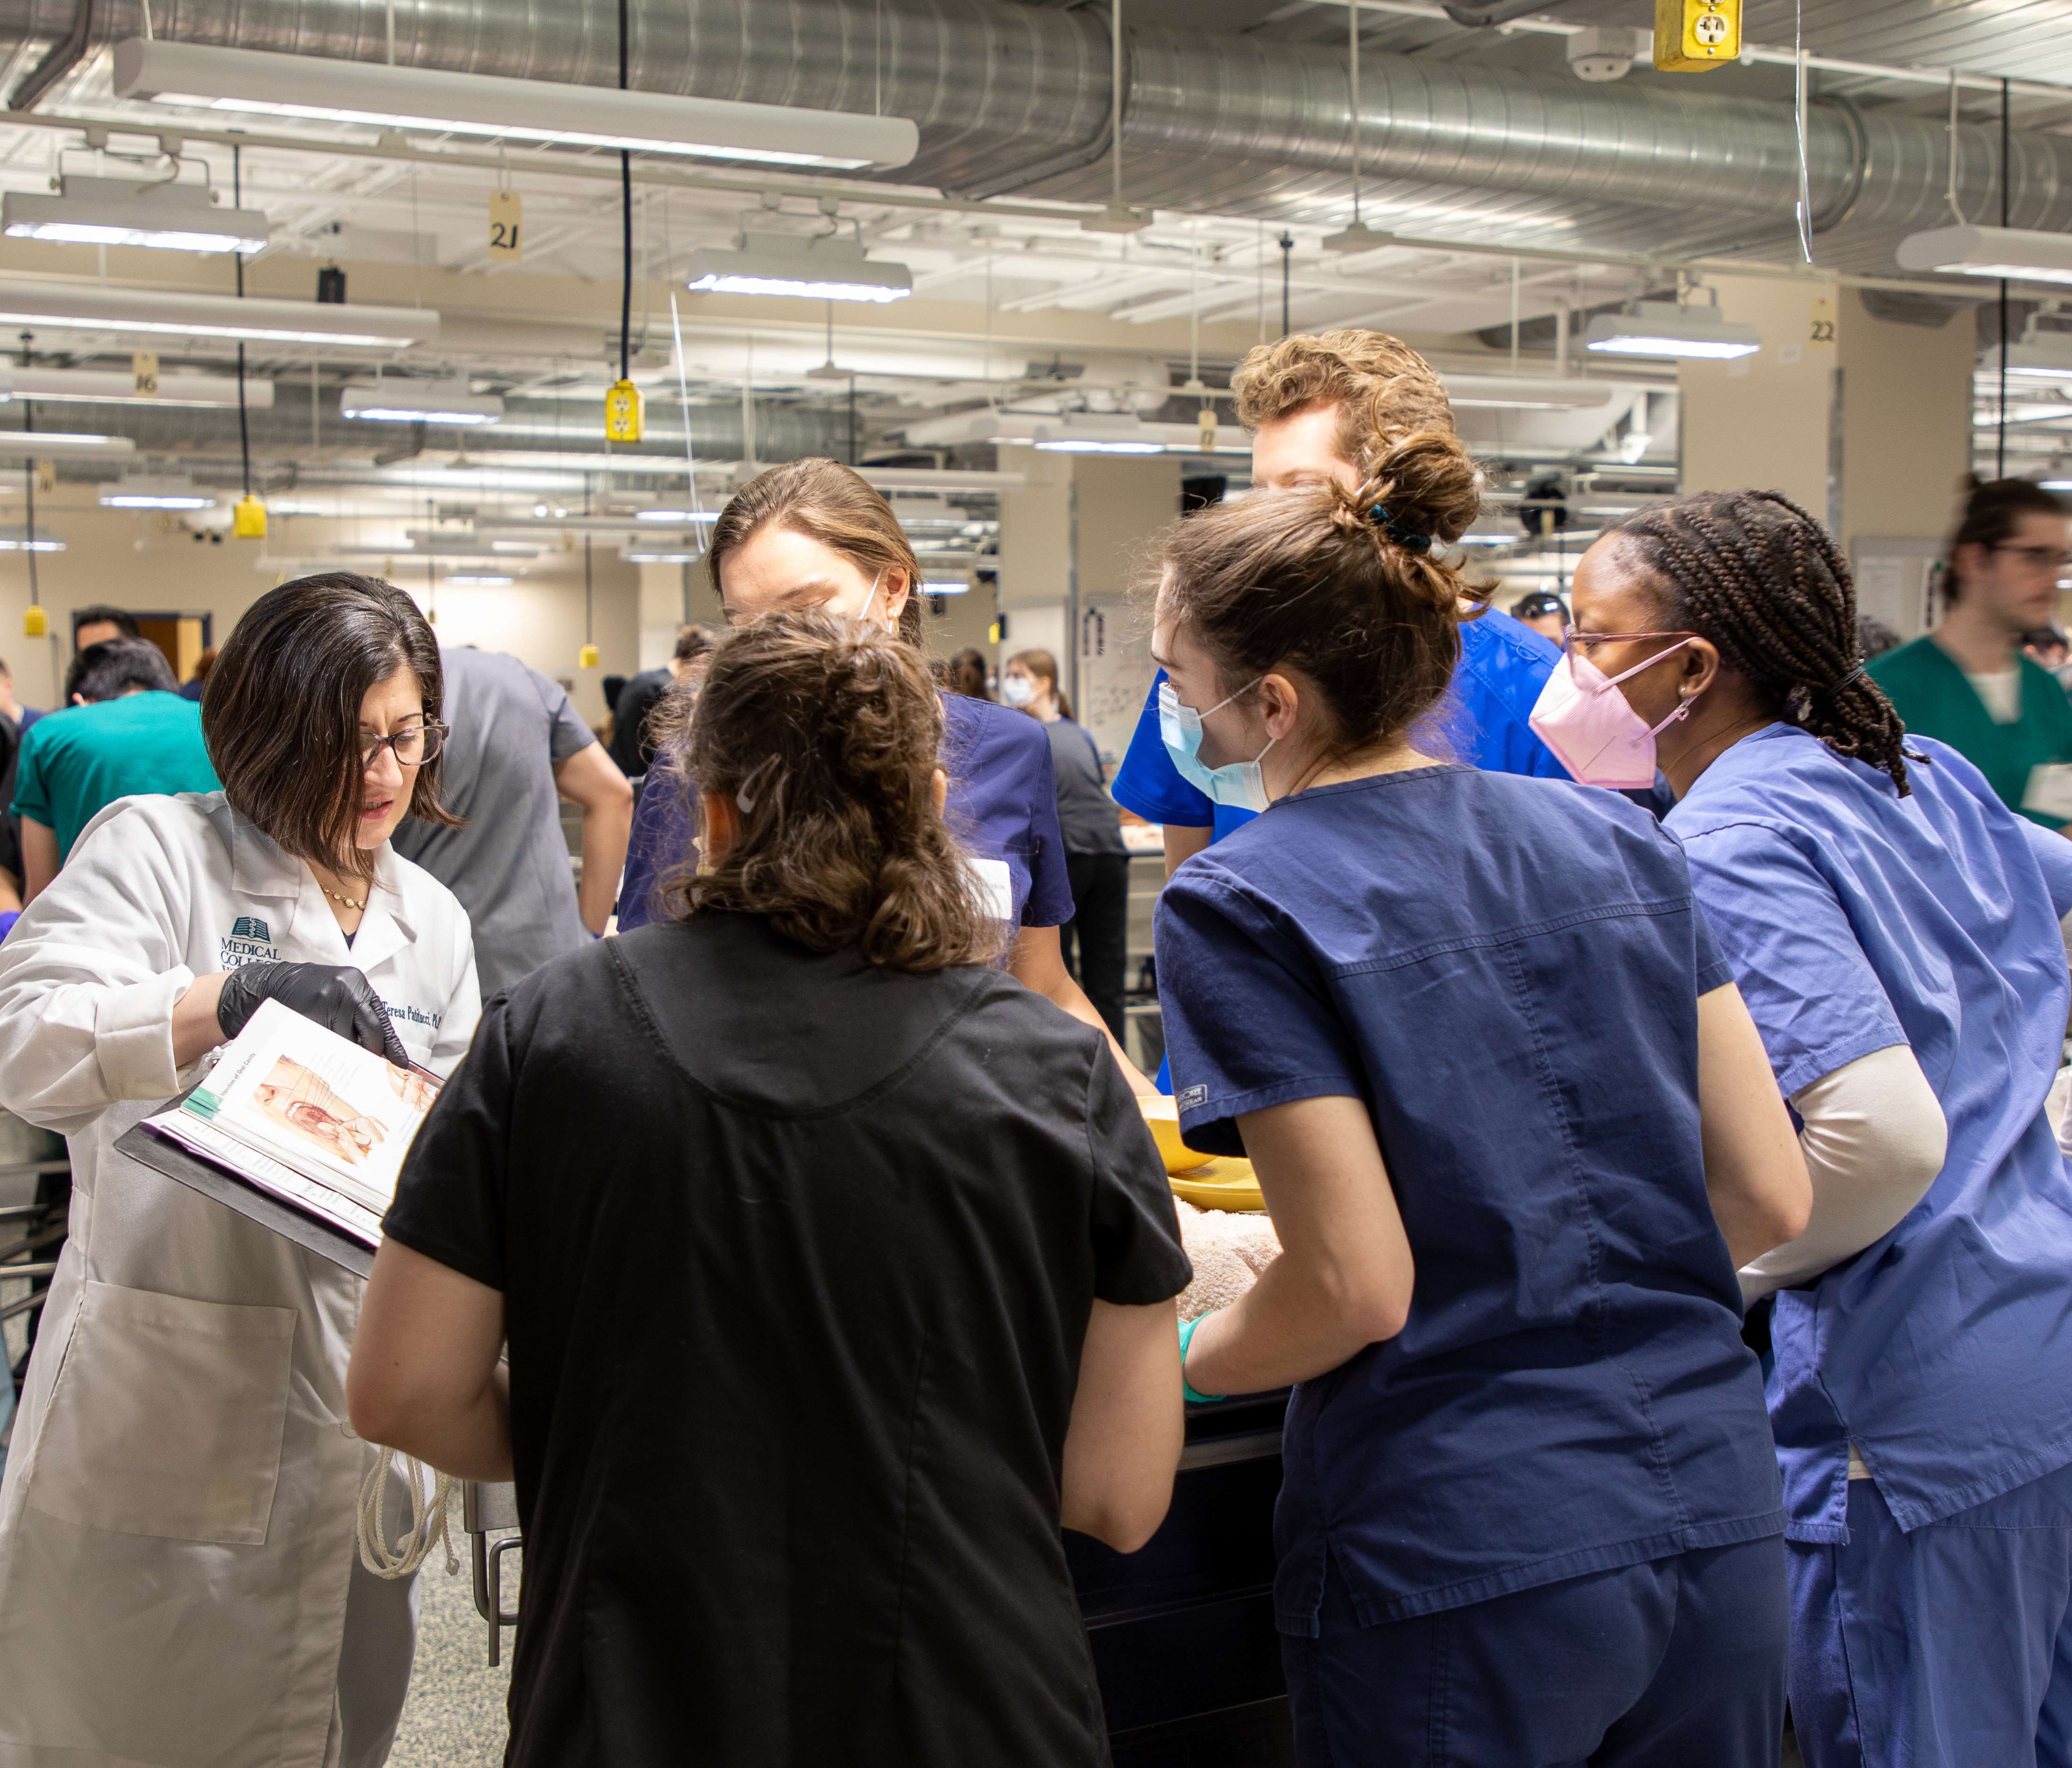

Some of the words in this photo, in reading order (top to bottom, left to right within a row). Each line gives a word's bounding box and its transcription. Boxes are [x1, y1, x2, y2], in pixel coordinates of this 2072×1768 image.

[490, 222, 518, 249] 21
[1810, 321, 1834, 341] 22
[137, 374, 157, 393] 16
[220, 950, 280, 967] COLL
[221, 937, 281, 960] MEDICAL
[381, 1001, 405, 1019] Teresa
[237, 1065, 247, 1074] Oral
[243, 1053, 257, 1065] Cavity
